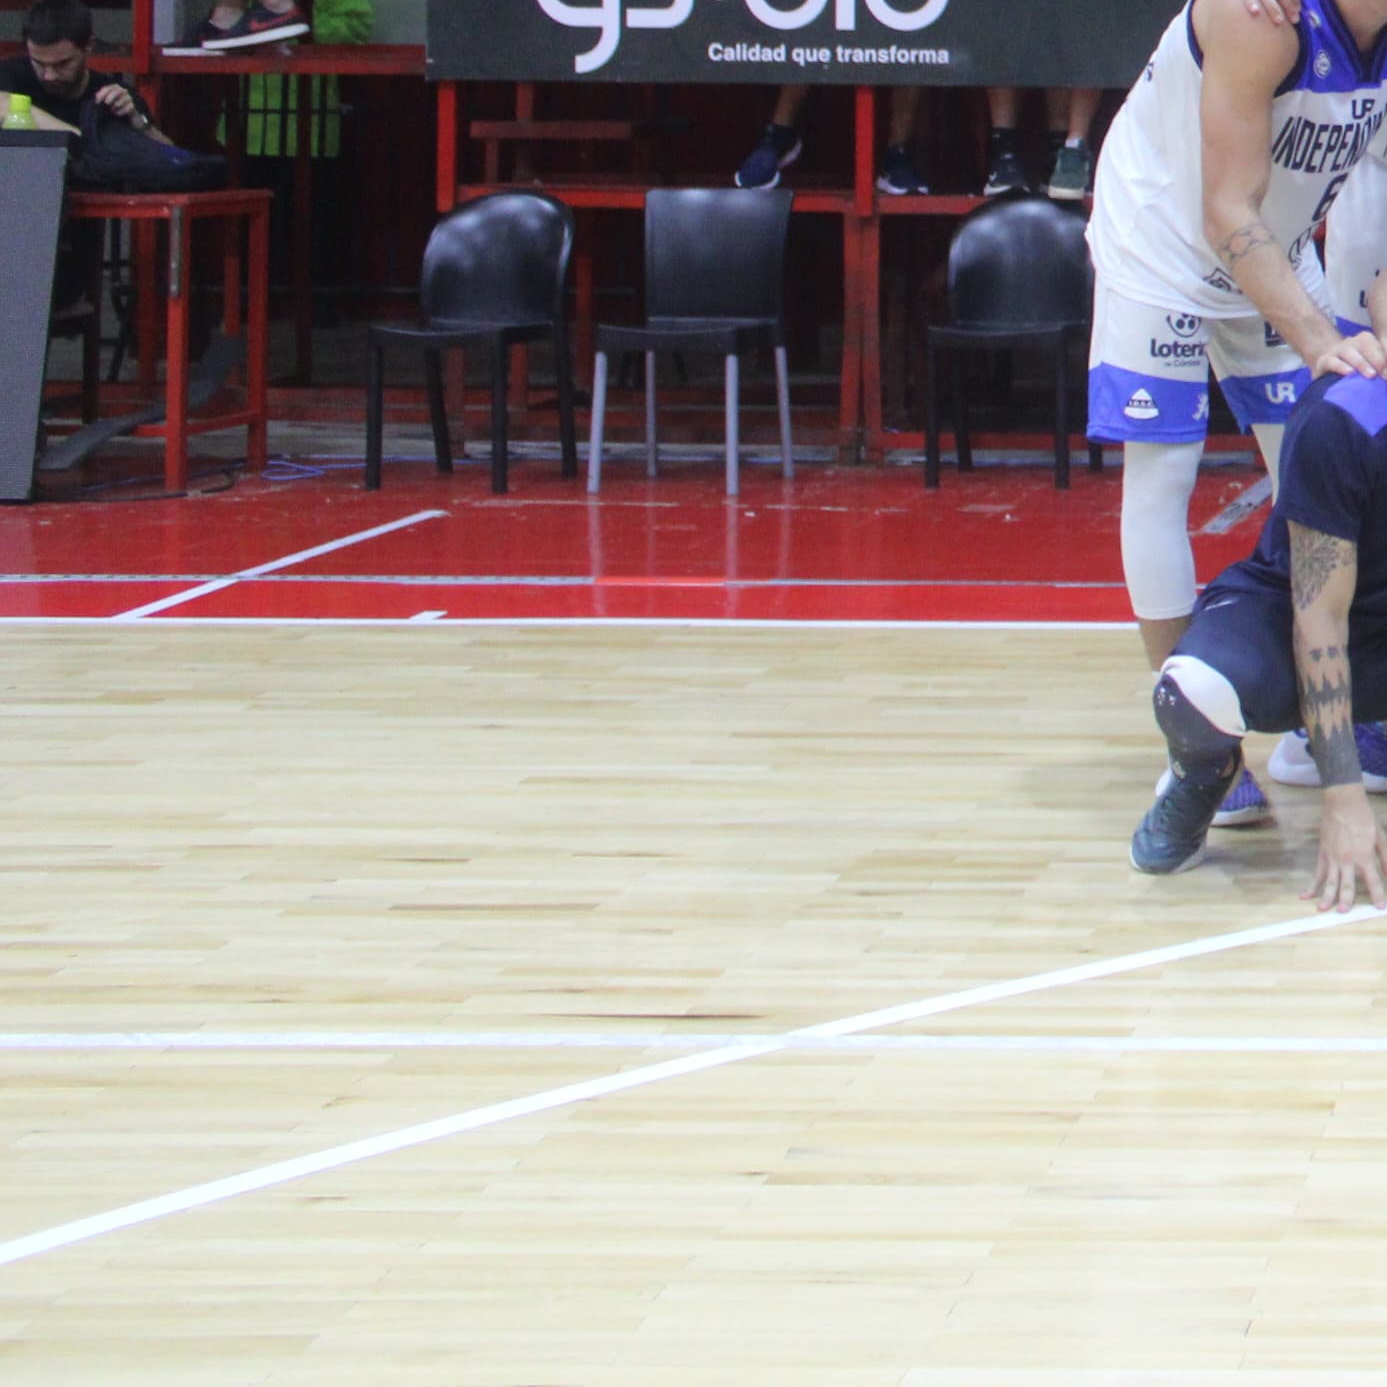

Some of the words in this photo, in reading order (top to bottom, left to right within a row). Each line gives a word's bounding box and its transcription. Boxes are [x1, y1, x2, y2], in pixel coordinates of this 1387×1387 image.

[707, 41, 787, 62] Calidad
[791, 47, 831, 67] que
[835, 44, 950, 64] transforma
[1264, 381, 1297, 405] UR
